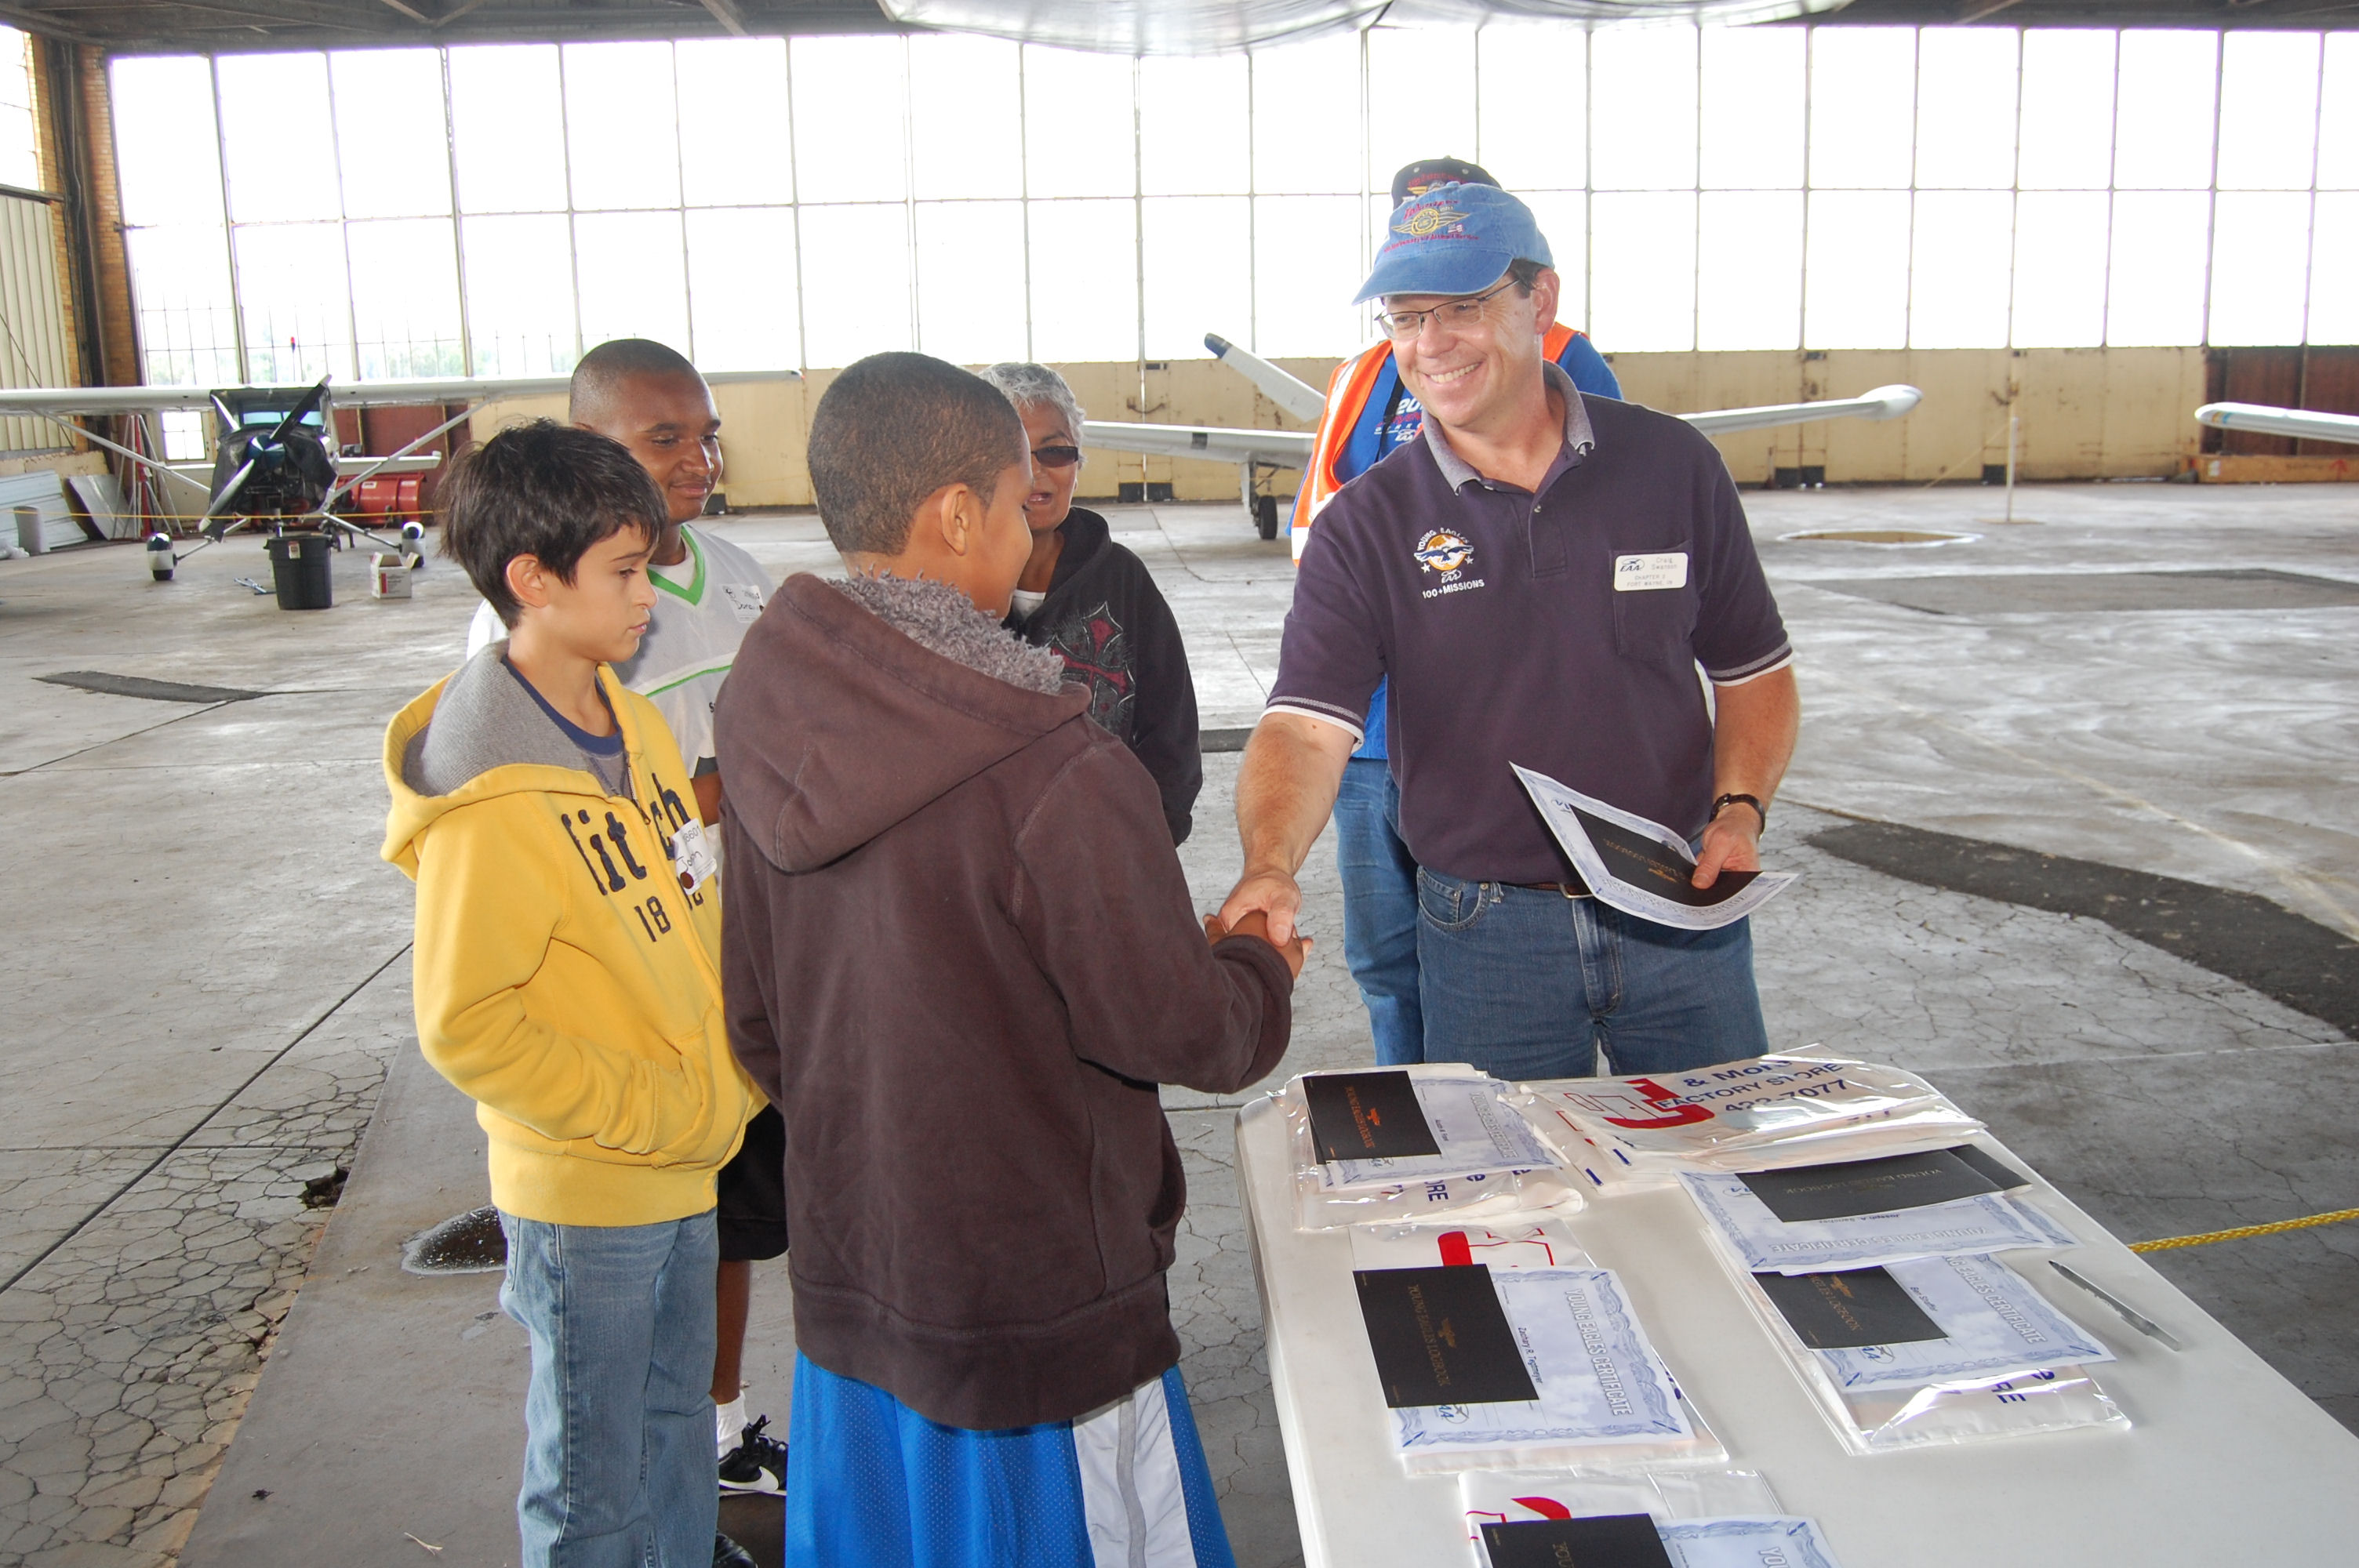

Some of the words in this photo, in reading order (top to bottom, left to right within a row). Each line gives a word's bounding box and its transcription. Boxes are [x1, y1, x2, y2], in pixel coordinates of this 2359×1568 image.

[1416, 530, 1437, 550] YOUNG
[634, 895, 671, 942] 18
[1656, 1081, 1763, 1109] FACTORY
[1683, 1078, 1710, 1087] &
[1564, 1287, 1594, 1321] YOUNG
[1954, 1262, 1995, 1295] EAGLES
[1983, 1292, 2048, 1345] CERTIFICATE
[1576, 1320, 1608, 1356] EAGLES
[1590, 1354, 1635, 1416] CERTIFICATE
